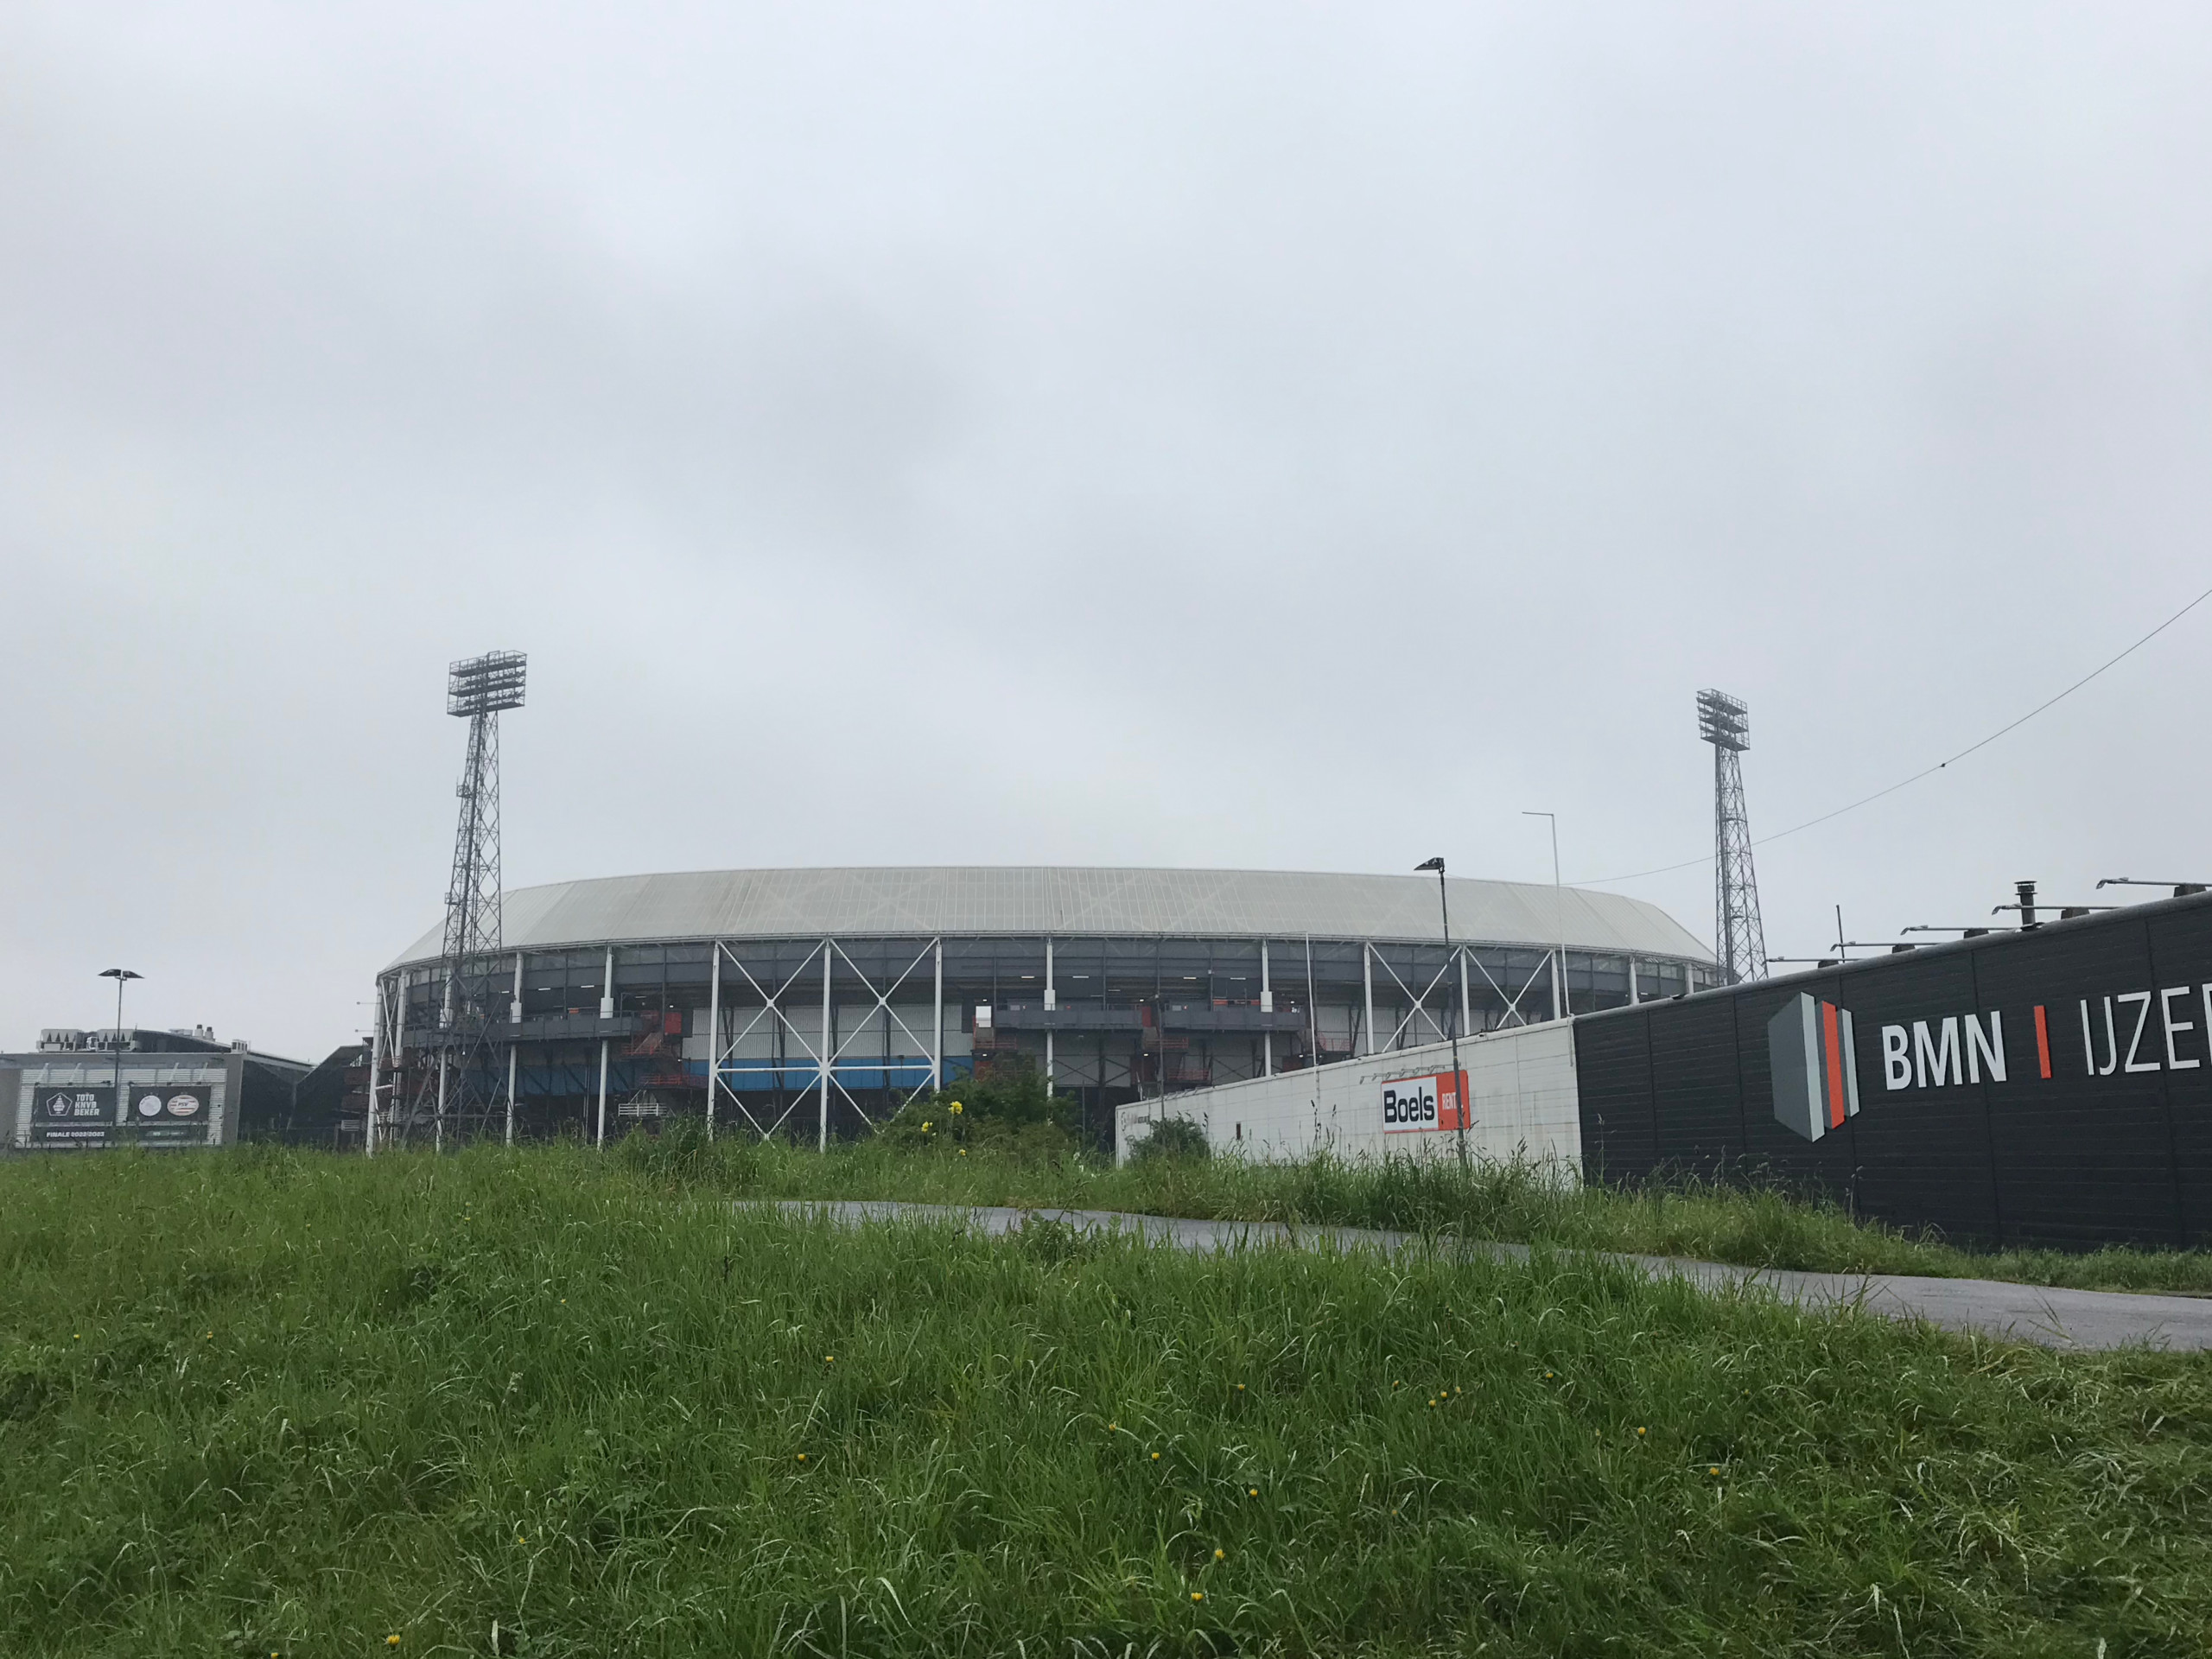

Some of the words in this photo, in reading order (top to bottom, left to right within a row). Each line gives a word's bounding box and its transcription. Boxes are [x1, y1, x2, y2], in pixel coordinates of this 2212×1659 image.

[1881, 1010, 2007, 1090] BMN
[2080, 982, 2212, 1076] IJZE
[73, 1108, 100, 1116] BEKER
[1383, 1086, 1435, 1123] Boels
[1441, 1092, 1464, 1110] RENT
